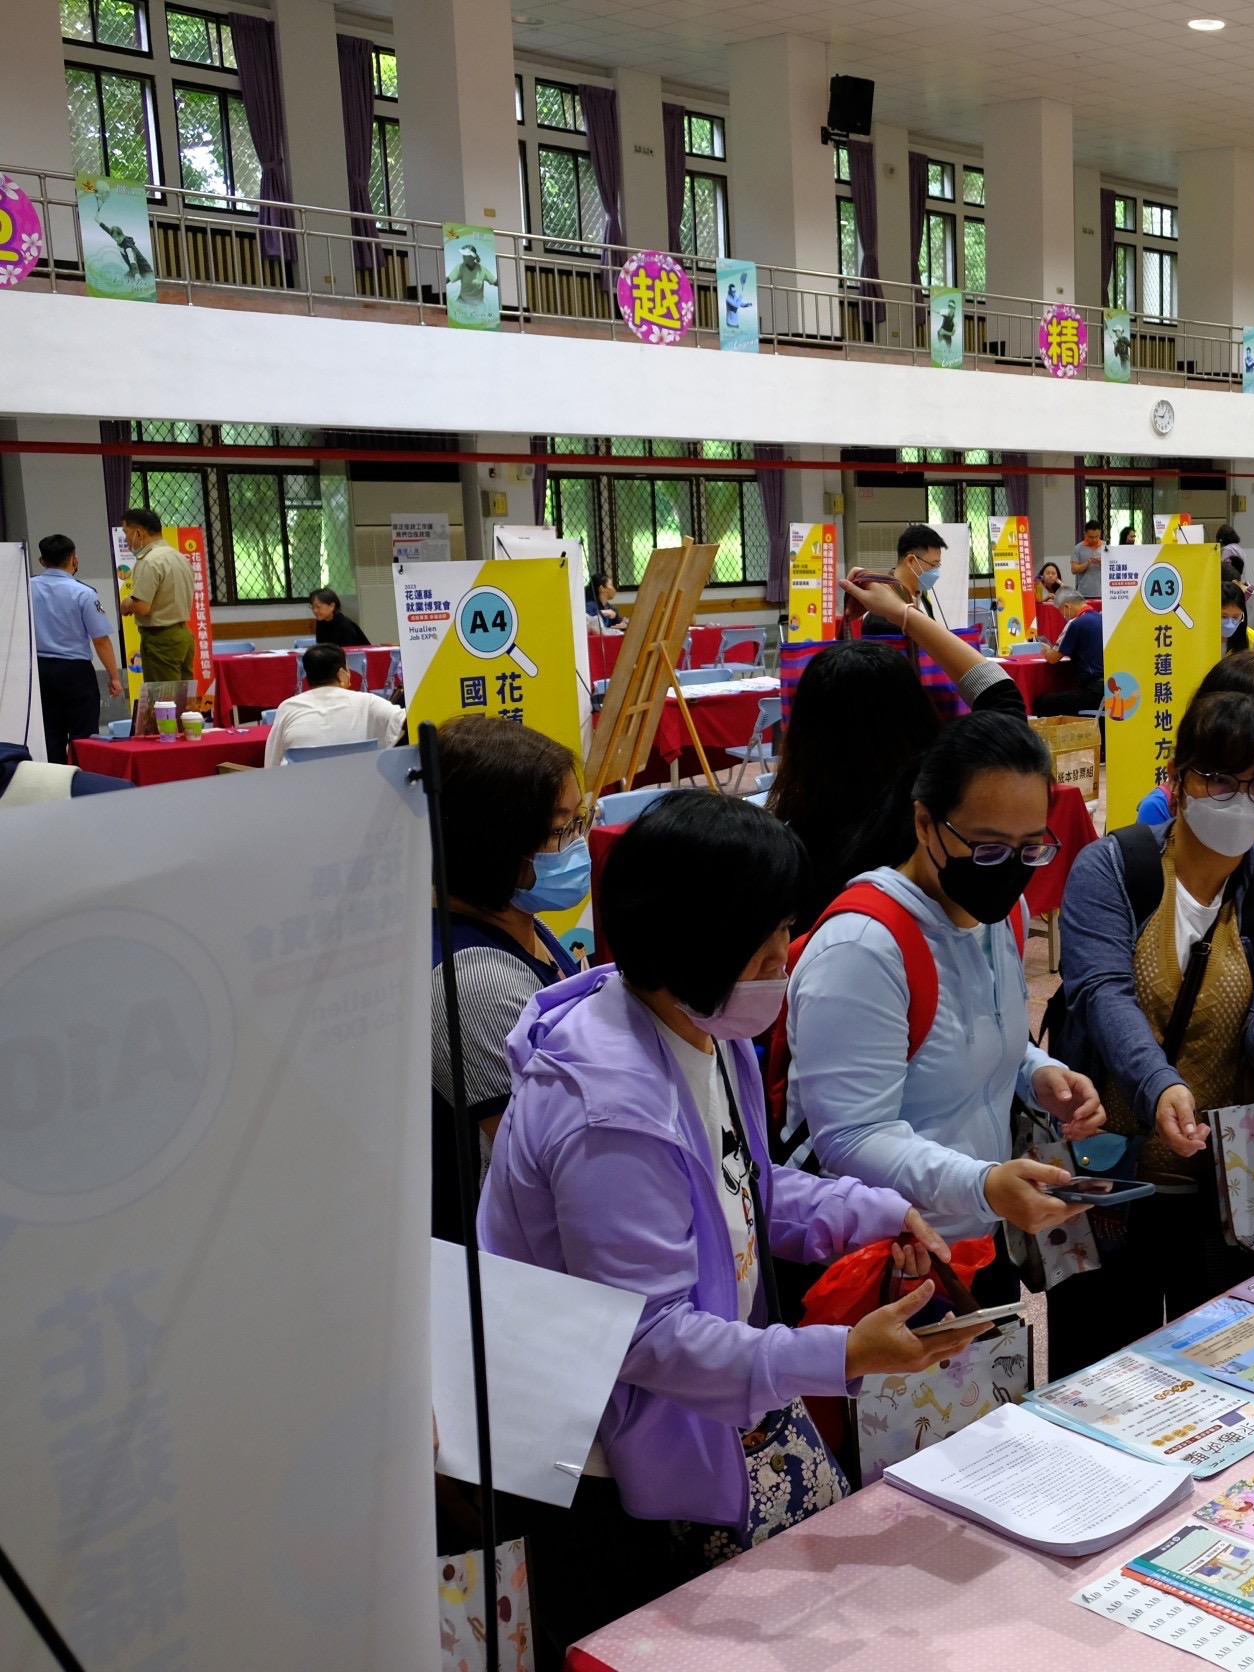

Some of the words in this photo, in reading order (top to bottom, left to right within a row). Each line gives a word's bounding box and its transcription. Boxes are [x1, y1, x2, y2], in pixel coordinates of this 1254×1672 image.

[632, 268, 681, 329] 越
[1048, 317, 1079, 366] 精
[1150, 579, 1175, 597] A3
[404, 589, 433, 601] 花蓮縣
[405, 600, 451, 613] 就業博覽會
[469, 610, 508, 634] A4
[408, 626, 437, 634] Hualien
[460, 675, 488, 714] 國
[1057, 765, 1094, 784] 紙本發票組
[1103, 1579, 1119, 1592] A10
[1123, 1587, 1140, 1600] A10
[1105, 1599, 1122, 1614] A10
[1144, 1596, 1160, 1609] A10
[1126, 1608, 1143, 1623] A10
[1166, 1606, 1182, 1619] A10
[1148, 1617, 1164, 1631] A10
[1187, 1615, 1204, 1628] A10
[1169, 1627, 1186, 1640] A10
[1209, 1624, 1225, 1637] A10
[1192, 1636, 1208, 1649] A10
[1231, 1633, 1248, 1647] A10
[1214, 1646, 1231, 1659] A10
[1237, 1656, 1254, 1670] A10
